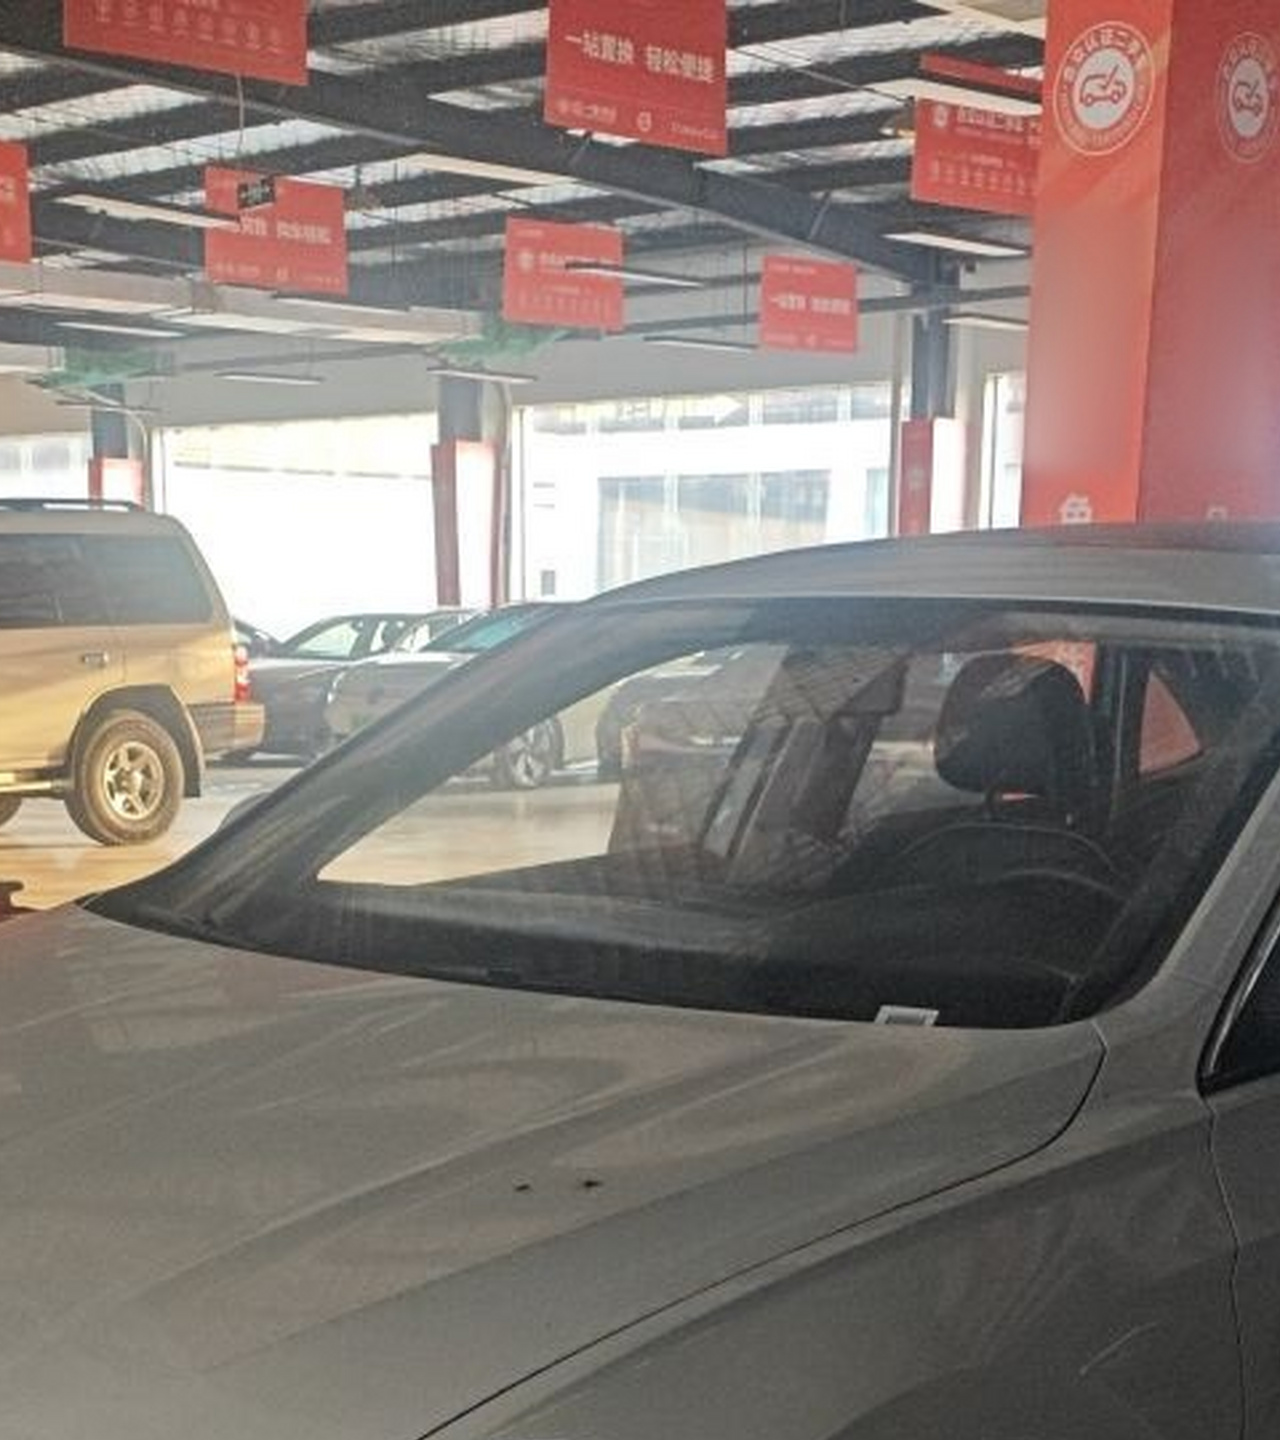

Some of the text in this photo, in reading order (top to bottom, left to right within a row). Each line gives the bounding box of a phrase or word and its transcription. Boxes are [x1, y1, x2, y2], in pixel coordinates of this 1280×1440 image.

[565, 29, 714, 84] 一站置换 轻松便捷
